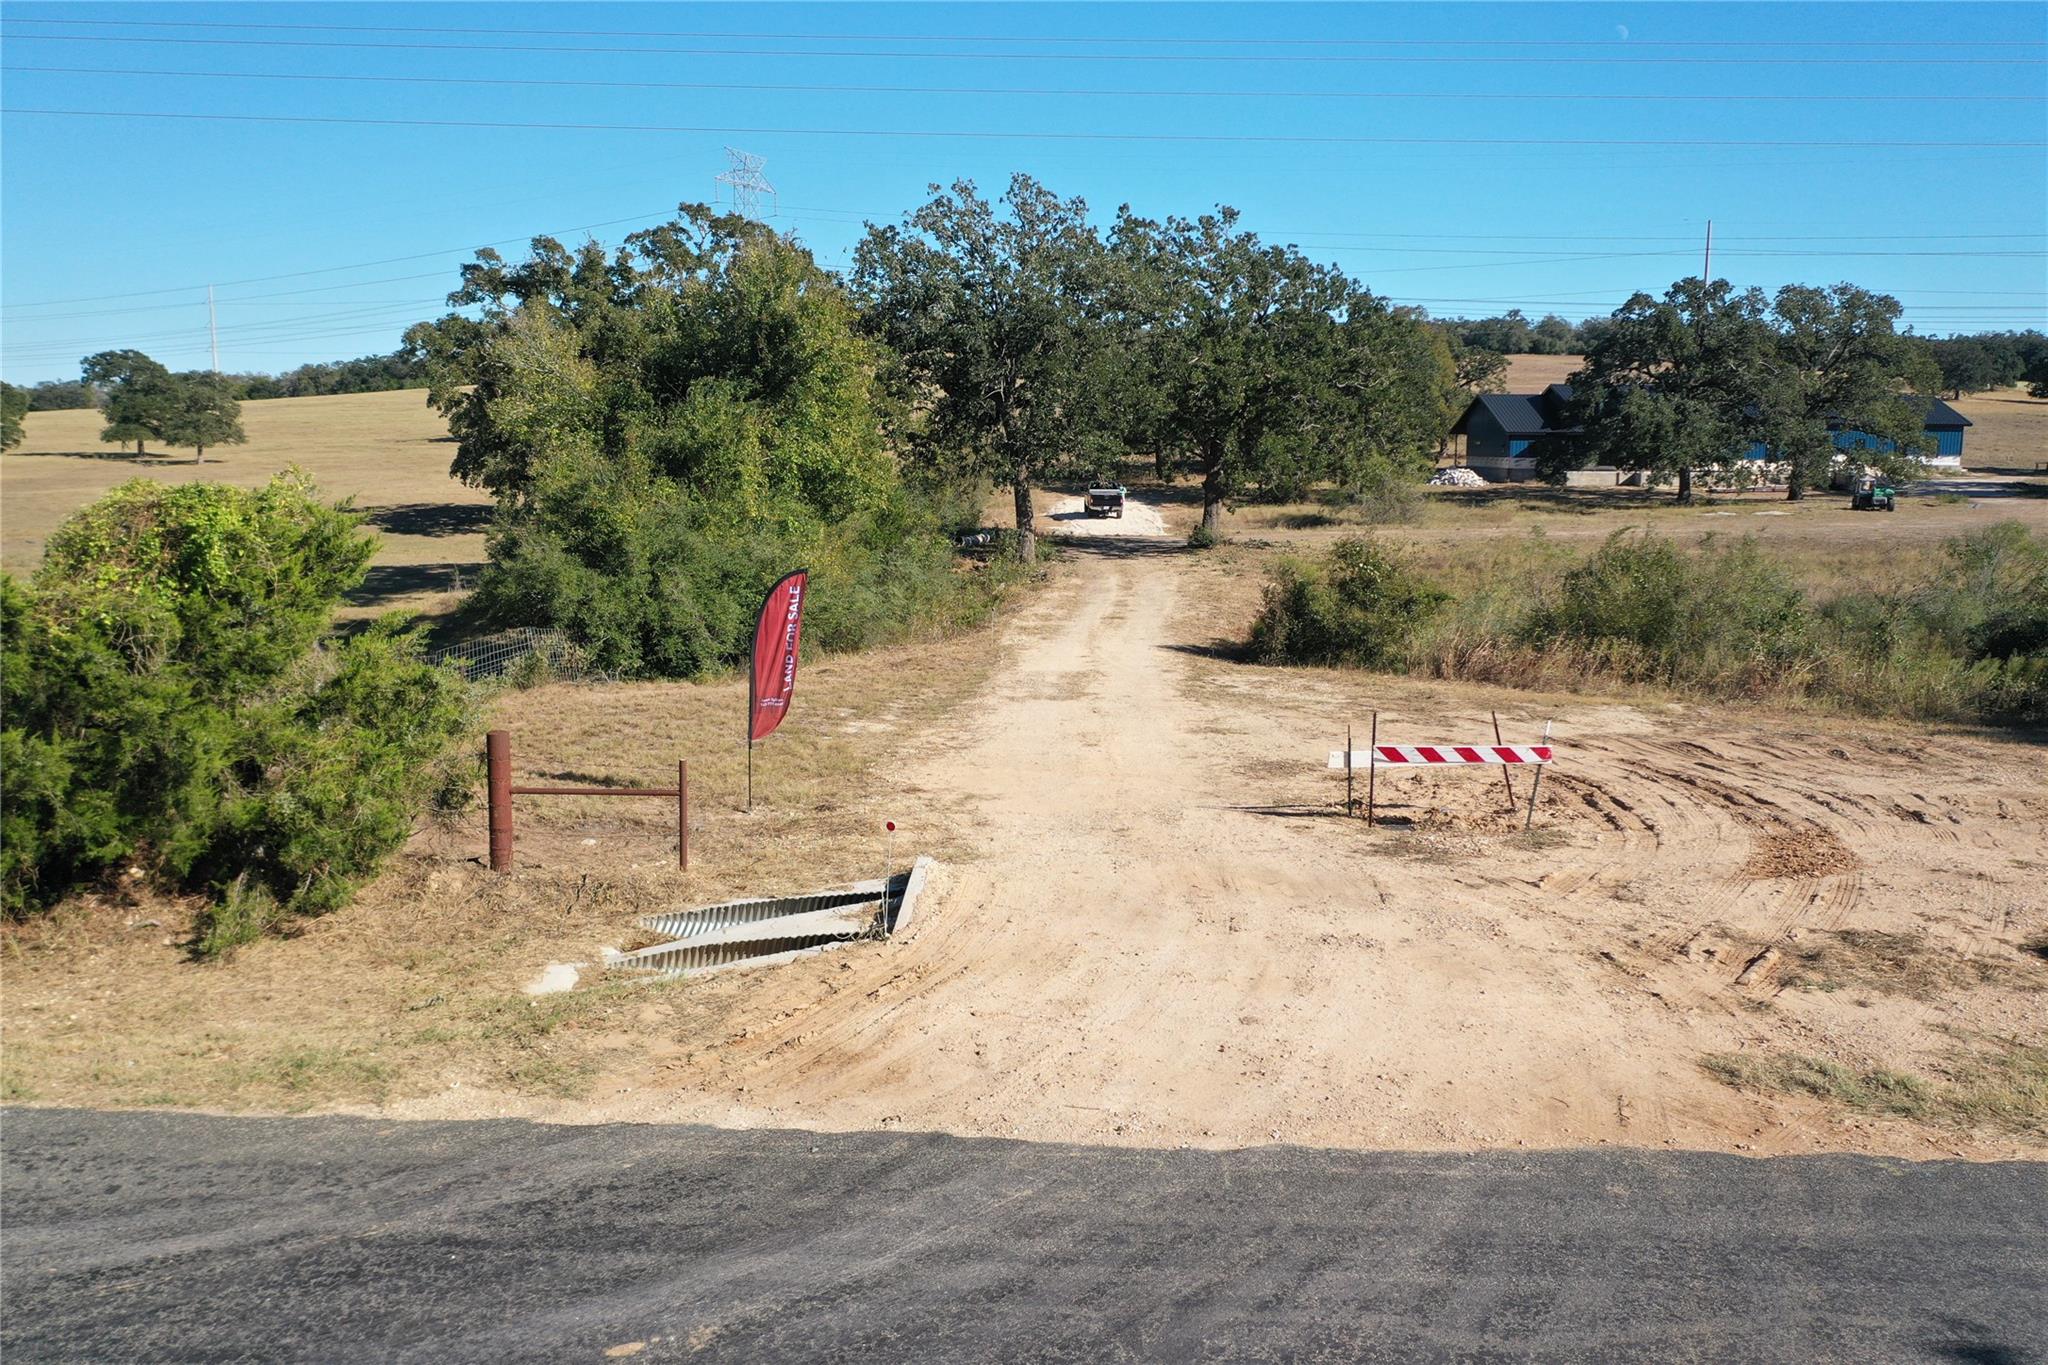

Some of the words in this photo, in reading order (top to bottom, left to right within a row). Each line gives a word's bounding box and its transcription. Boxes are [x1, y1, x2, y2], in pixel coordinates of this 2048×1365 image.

[788, 585, 800, 620] SALE
[785, 623, 797, 651] FOR
[783, 655, 794, 692] LAND
